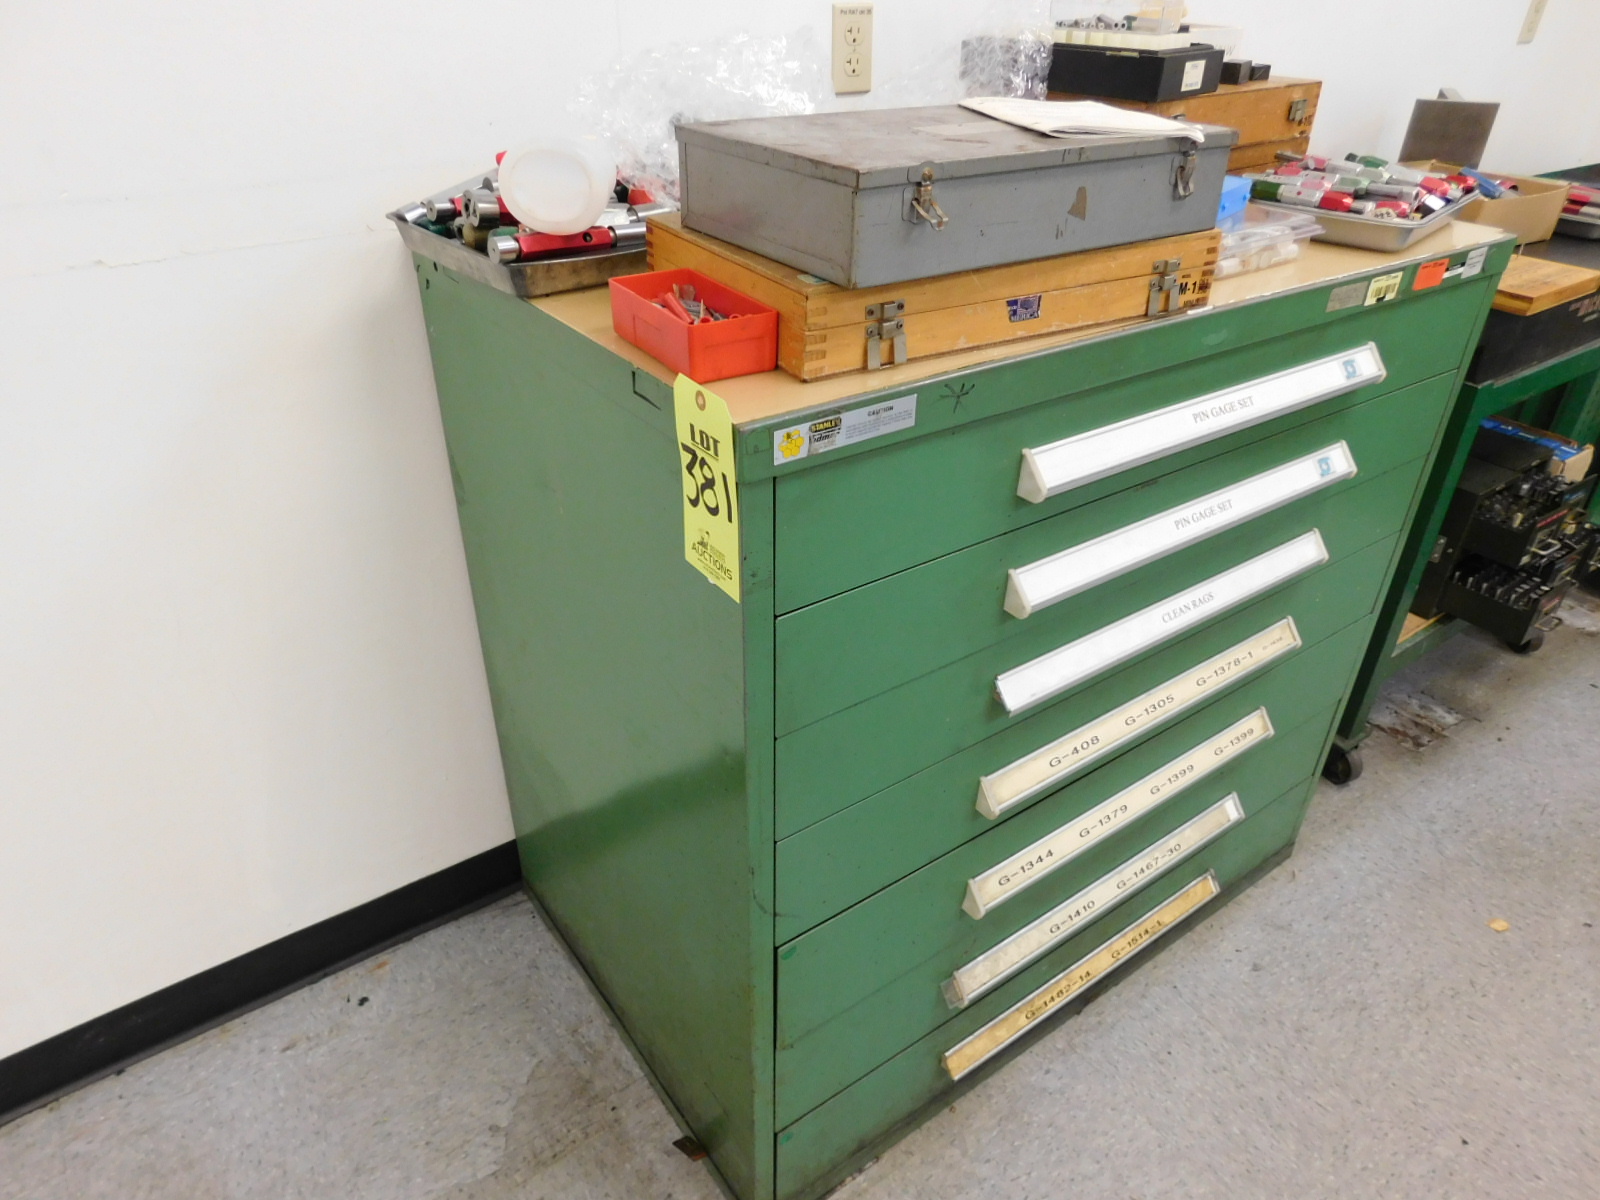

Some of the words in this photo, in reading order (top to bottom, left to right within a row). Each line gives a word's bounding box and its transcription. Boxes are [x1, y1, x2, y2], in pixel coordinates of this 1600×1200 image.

[867, 405, 894, 417] CAUTION
[1192, 407, 1211, 424] PIN
[1211, 401, 1238, 418] GAGE
[1238, 396, 1255, 411] SET
[689, 422, 721, 457] LOT
[681, 441, 733, 523] 381
[1174, 514, 1191, 531] PIN
[1192, 506, 1217, 524] GAGE
[1218, 499, 1234, 515] SET
[692, 541, 733, 581] AUCTIONS
[1162, 602, 1191, 623] CLEAN
[1192, 591, 1215, 609] RAGS
[1049, 735, 1101, 768] G-408
[1124, 694, 1176, 727] G-1305
[1195, 650, 1255, 688] G-1378-1
[998, 848, 1055, 887] G-1344
[1079, 804, 1129, 839] G-1379
[1150, 764, 1195, 796] G-1399
[1214, 727, 1255, 757] G-1399
[1049, 900, 1096, 935] G-1410
[1116, 843, 1183, 891] G-1467-30
